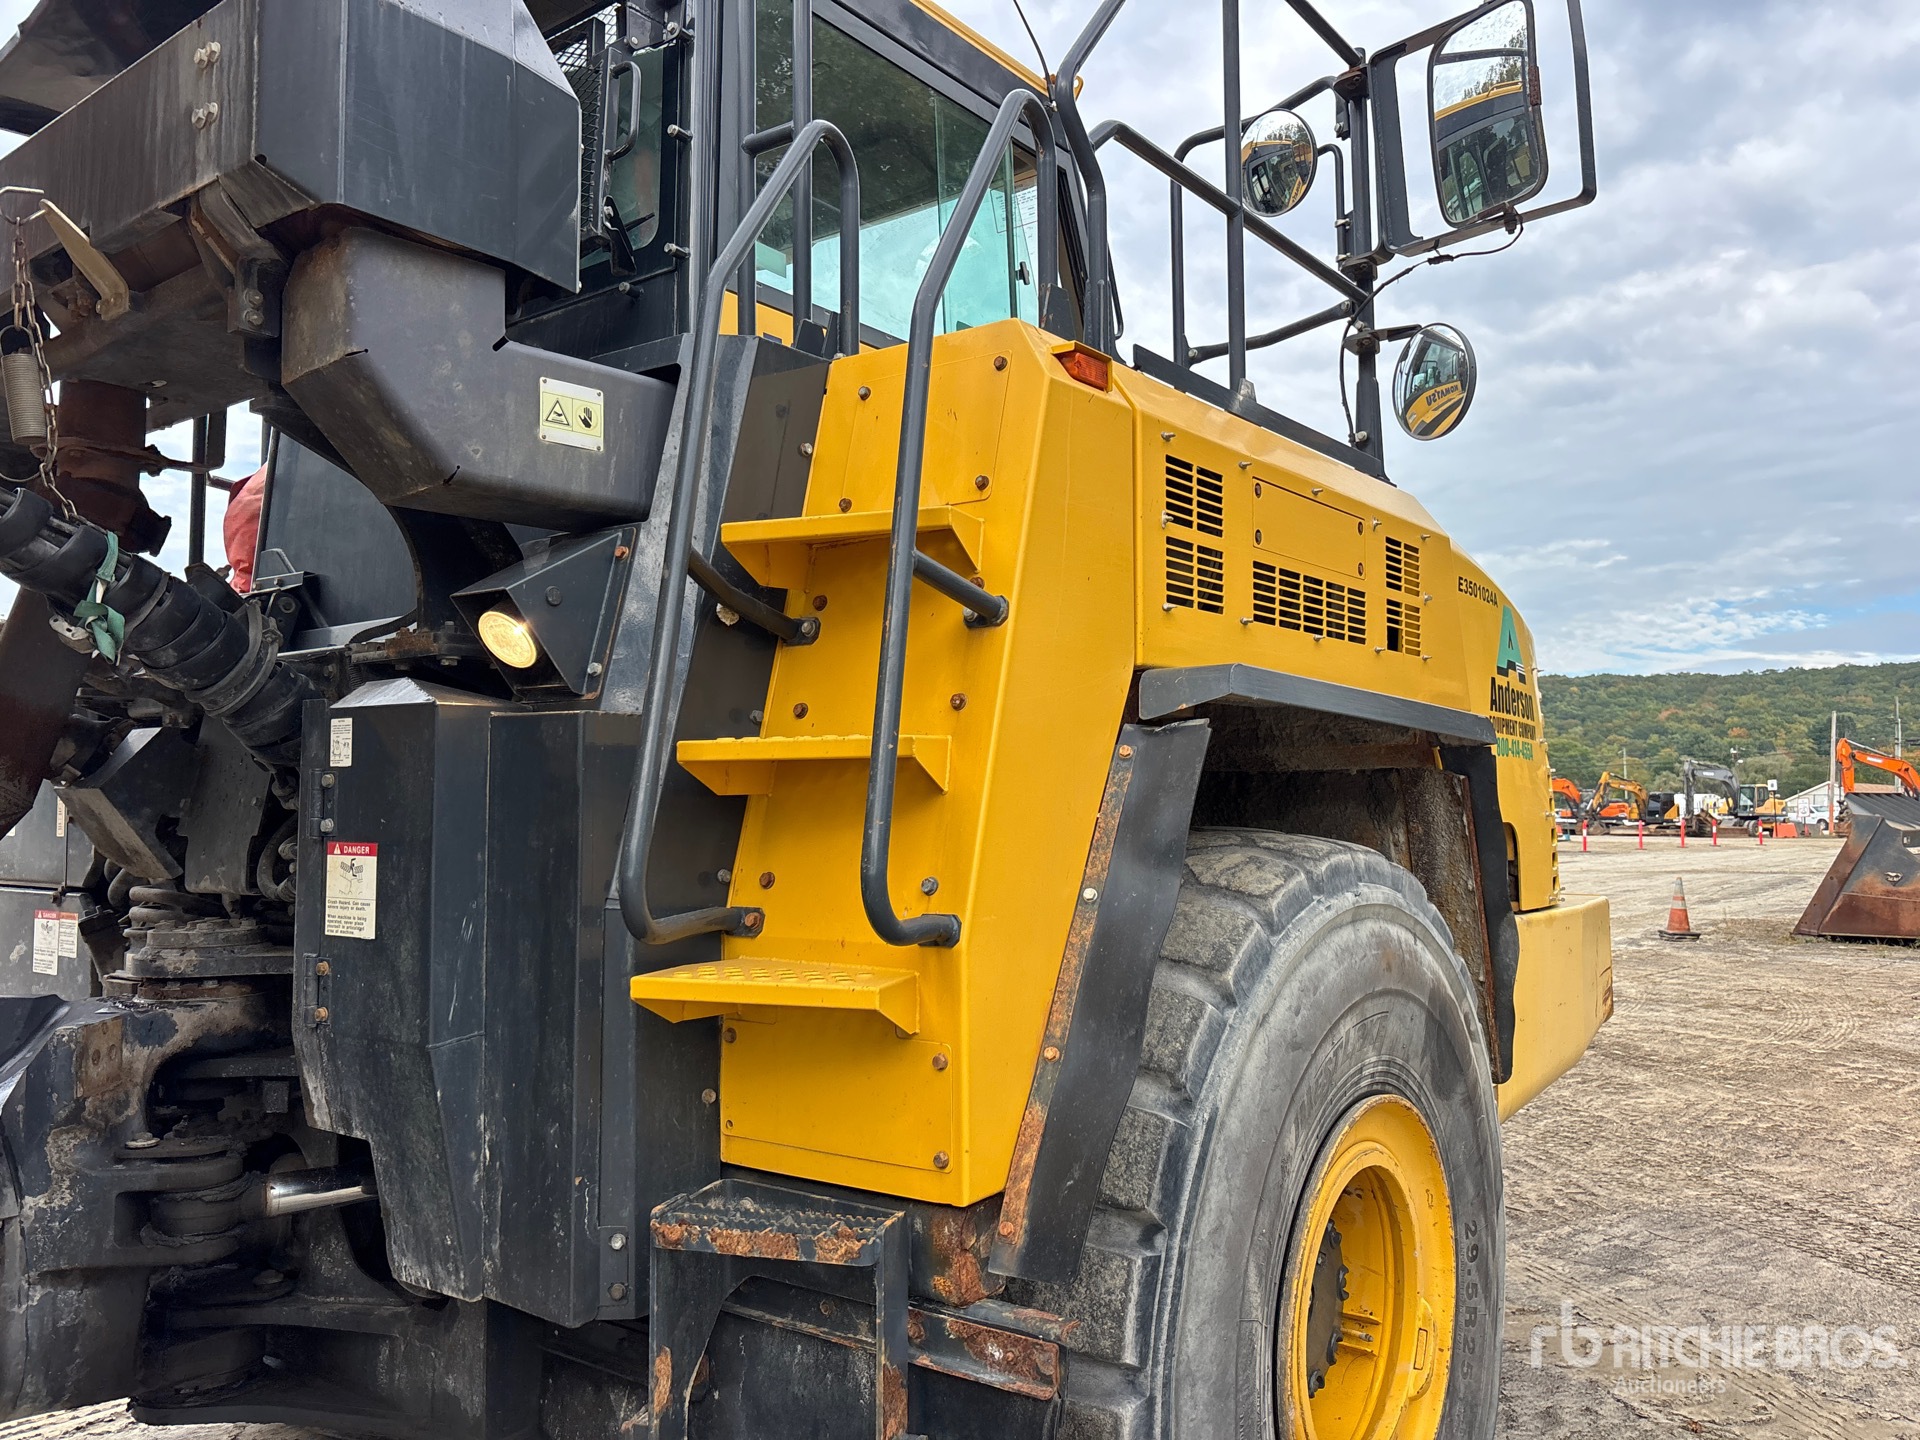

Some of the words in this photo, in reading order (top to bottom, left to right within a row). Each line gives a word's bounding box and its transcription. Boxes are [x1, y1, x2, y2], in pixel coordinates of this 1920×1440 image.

[1458, 576, 1498, 608] E3501024A
[1490, 677, 1535, 722] Anderson
[343, 845, 370, 854] DANGER
